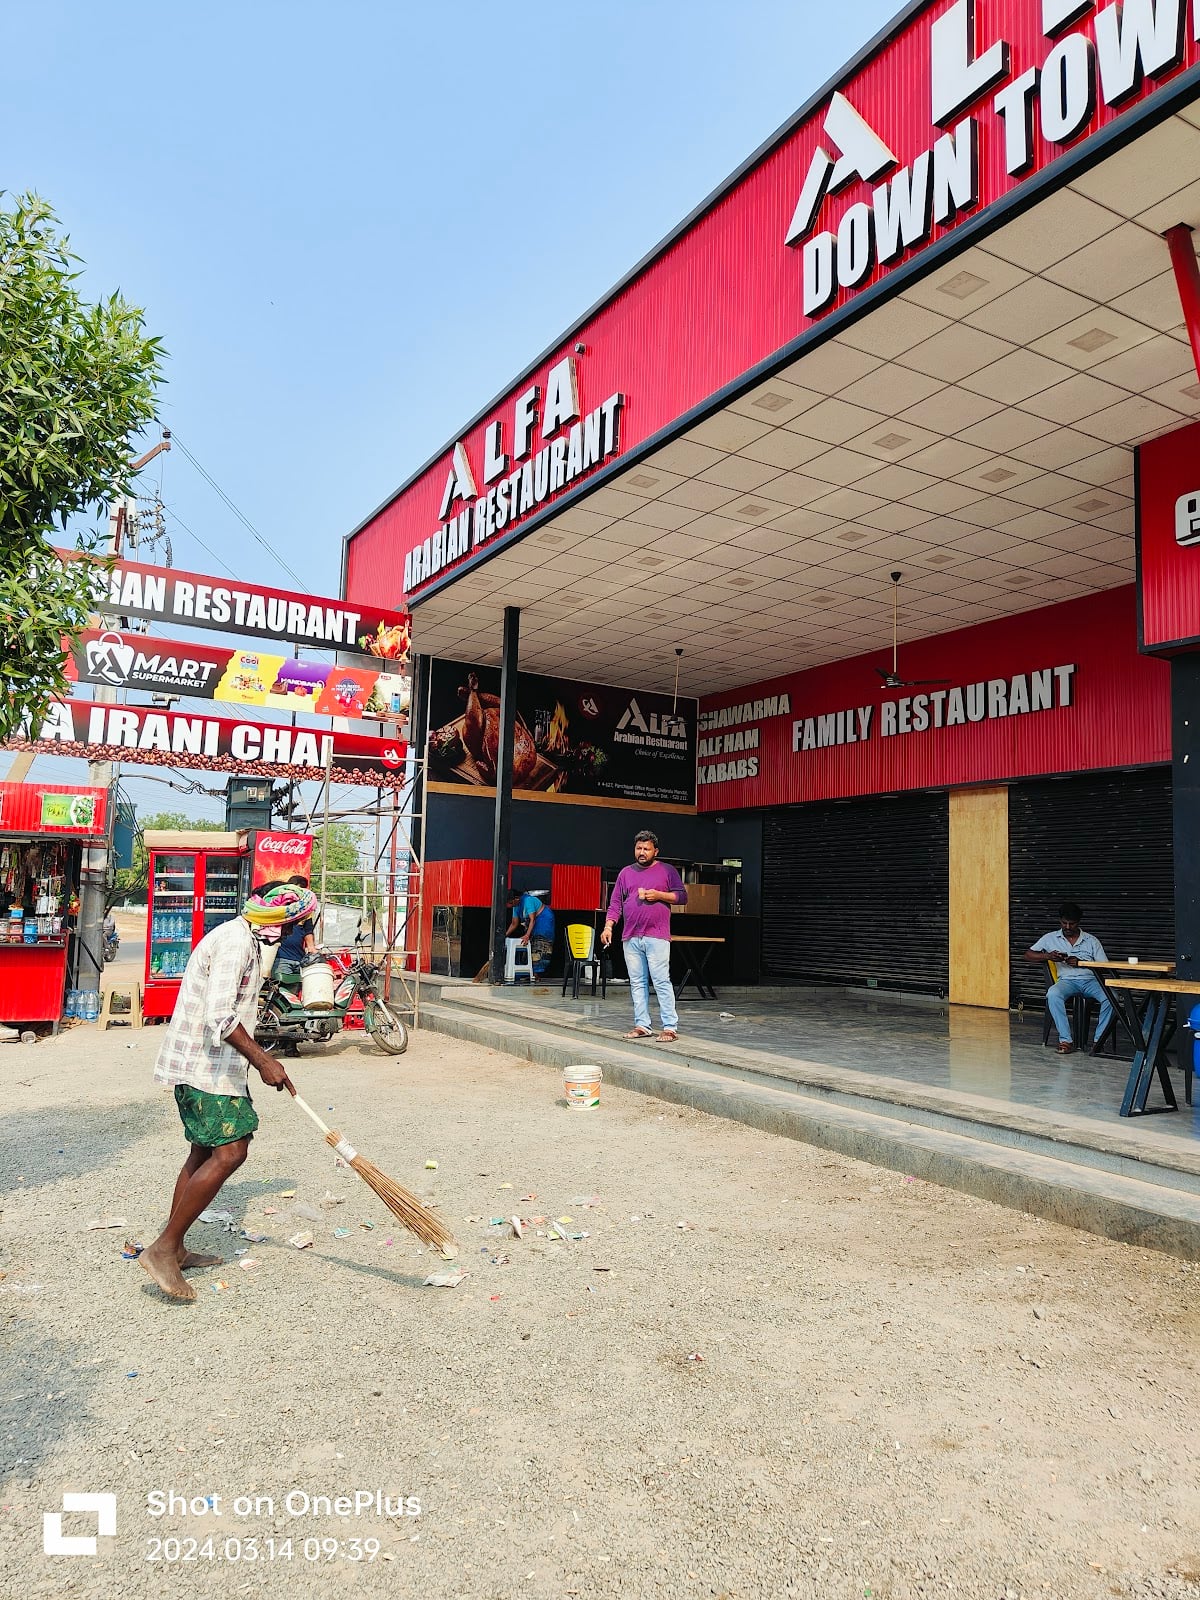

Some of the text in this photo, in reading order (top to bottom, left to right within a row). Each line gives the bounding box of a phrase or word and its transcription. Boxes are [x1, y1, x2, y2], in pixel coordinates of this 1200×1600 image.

[803, 0, 1200, 318] DOWN TOW
[438, 356, 580, 521] ALFA
[403, 392, 625, 594] ARABIAN RESTAURANT
[173, 578, 361, 645] RESTAURANT
[132, 671, 207, 689] SUPERMARKET
[133, 652, 218, 681] MART
[88, 707, 221, 756] IRANI
[699, 694, 790, 731] SHAWARMA
[792, 663, 1077, 753] FAMILY RESTAURANT
[613, 731, 645, 745] Arabian
[698, 757, 758, 785] KABABS
